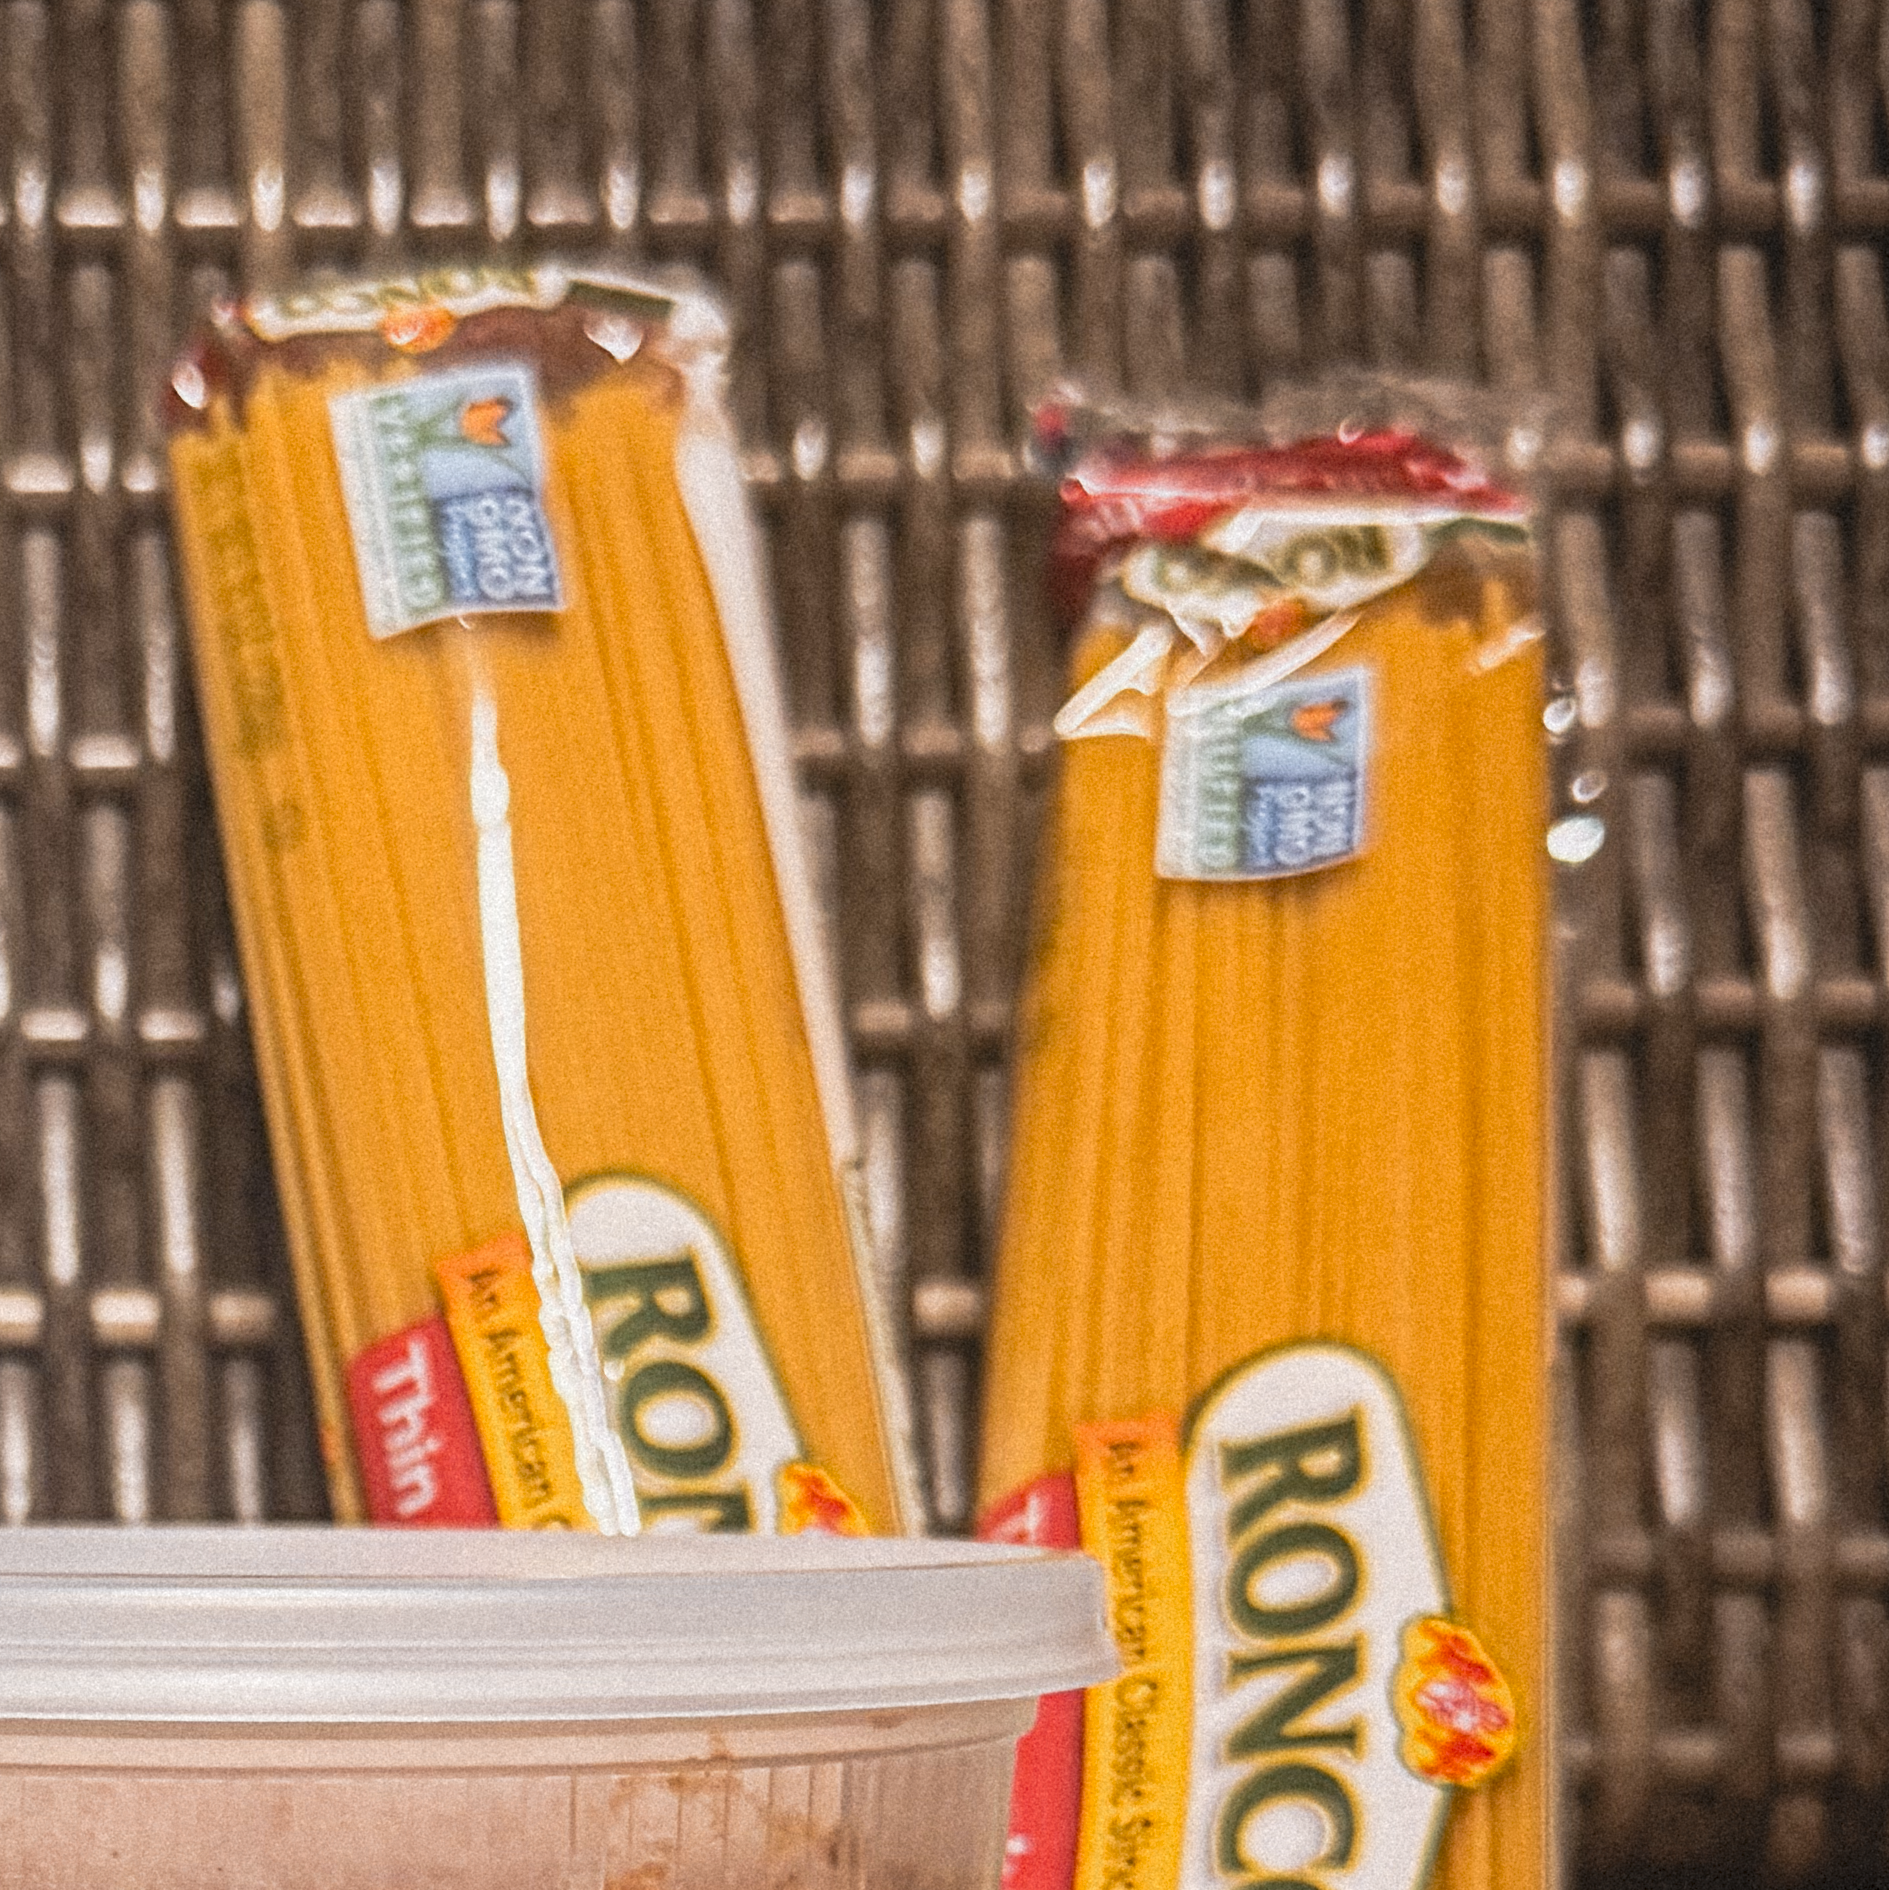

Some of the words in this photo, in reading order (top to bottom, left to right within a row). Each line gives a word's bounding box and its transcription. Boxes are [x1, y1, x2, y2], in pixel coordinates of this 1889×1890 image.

[465, 496, 514, 599] GMO
[370, 1337, 446, 1518] Thin
[487, 1324, 553, 1508] American
[1110, 1678, 1160, 1806] Classic
